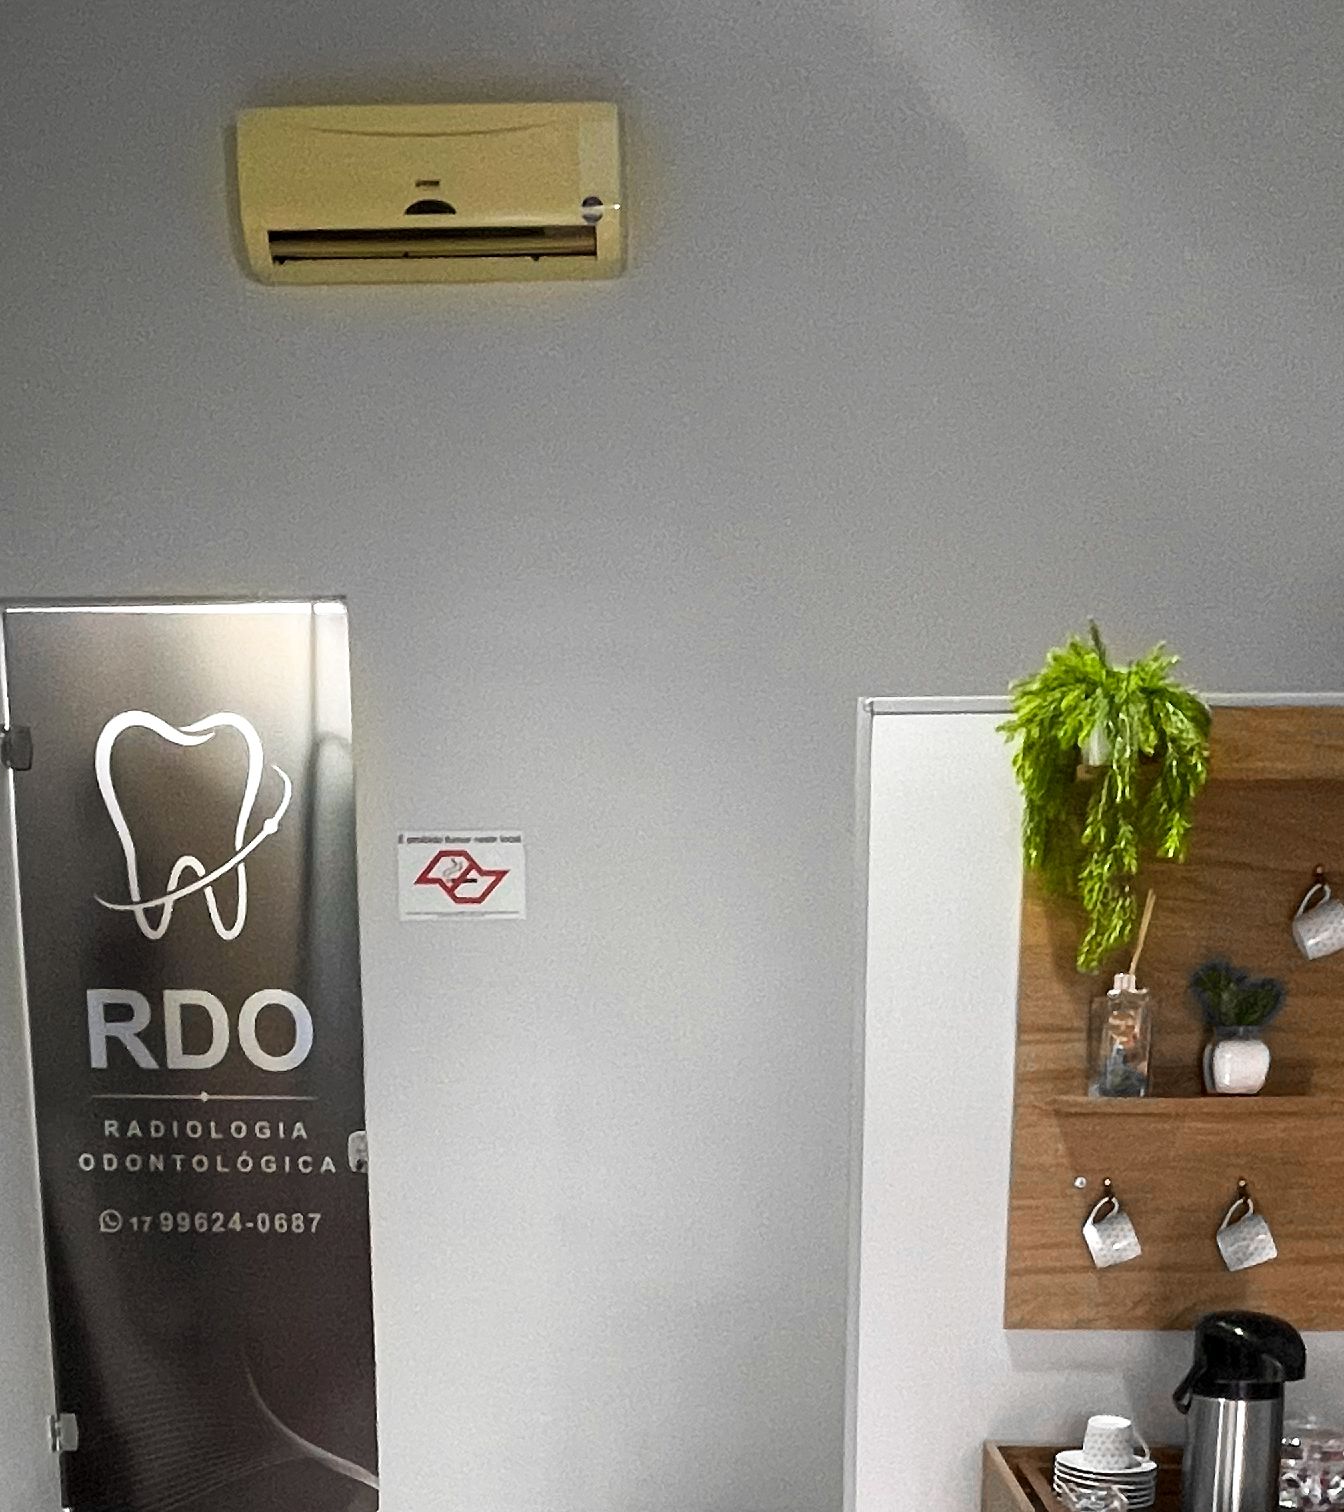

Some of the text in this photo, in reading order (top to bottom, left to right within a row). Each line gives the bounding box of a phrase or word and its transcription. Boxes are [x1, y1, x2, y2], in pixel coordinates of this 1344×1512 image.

[86, 988, 314, 1072] RDO
[104, 1119, 308, 1140] RADIOLOGIA
[77, 1150, 337, 1174] ODONTOLÓGICA
[128, 1211, 322, 1234] 17 99624-0687
